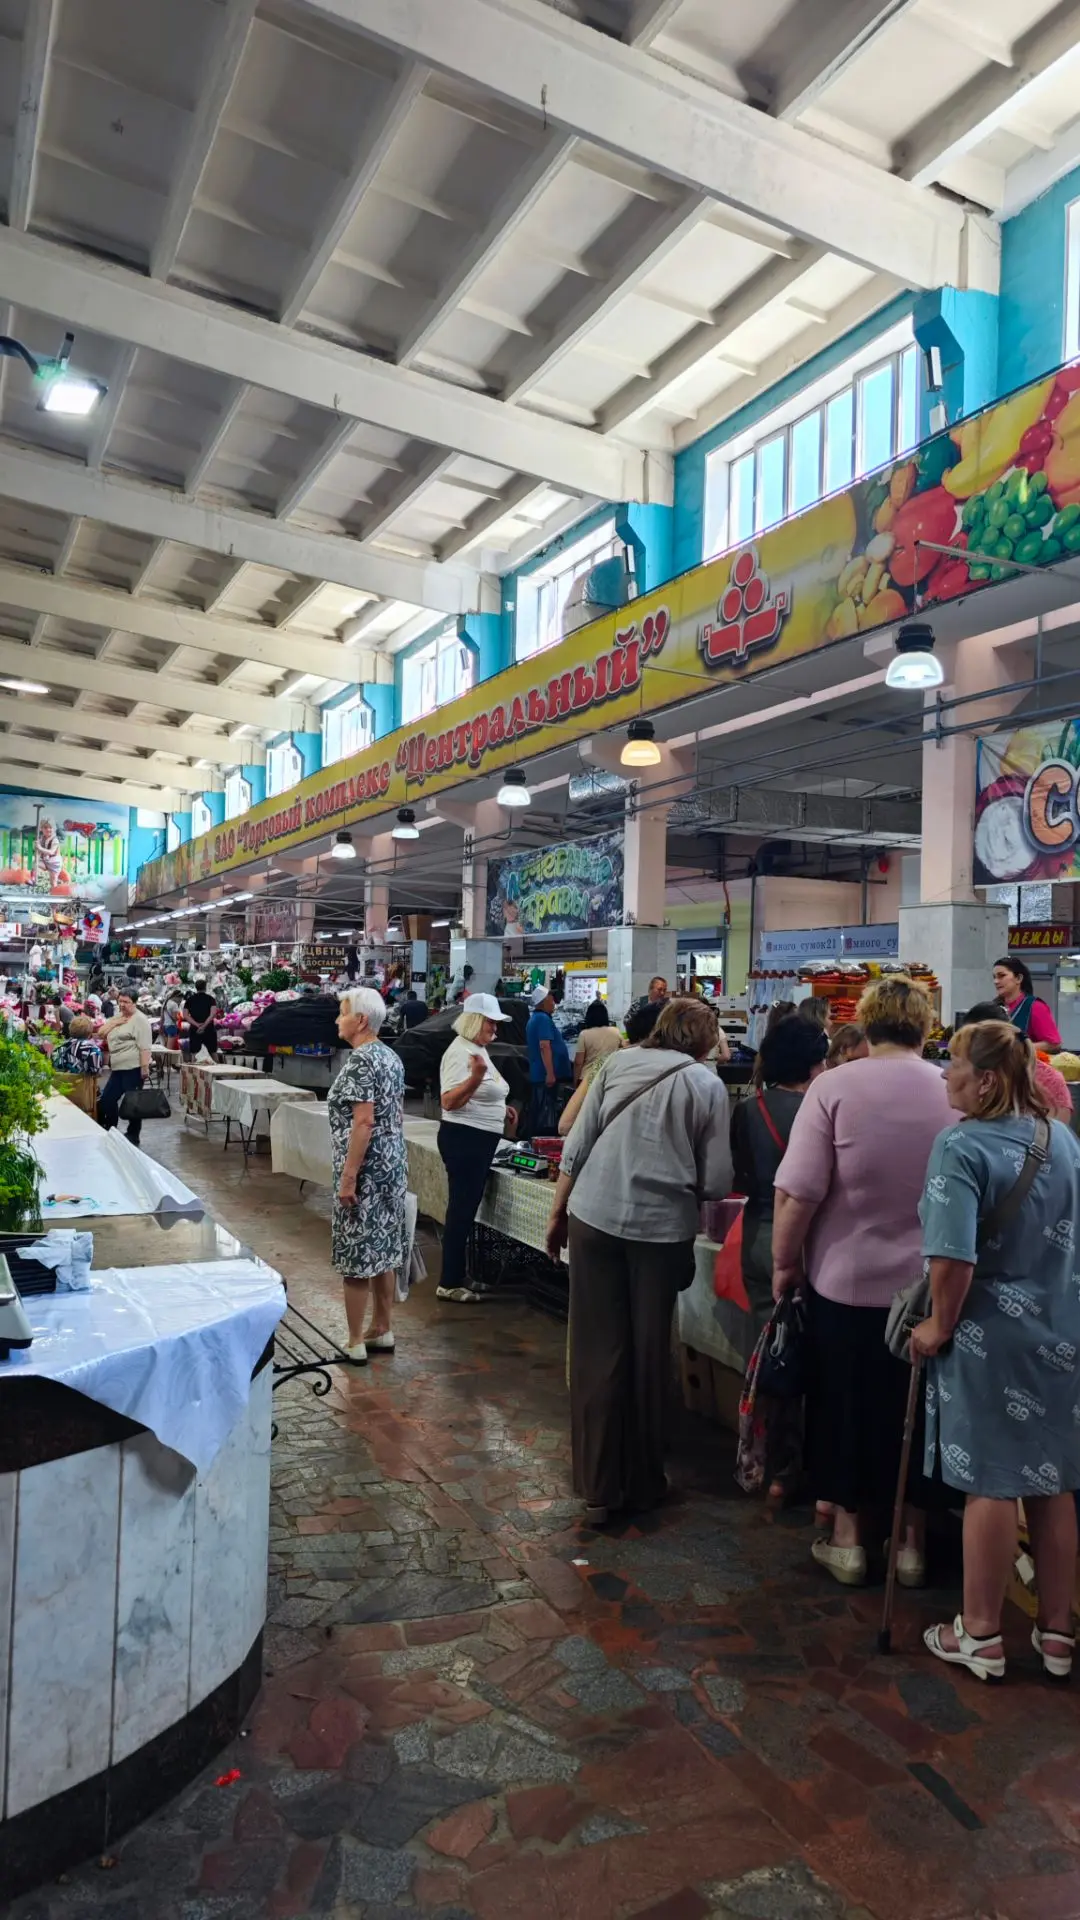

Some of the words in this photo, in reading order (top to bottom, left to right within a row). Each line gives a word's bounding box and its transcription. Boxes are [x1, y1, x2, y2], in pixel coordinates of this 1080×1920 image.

[215, 829, 235, 863] ЗАО
[306, 761, 390, 825] комплекс
[306, 946, 345, 957] ЦВЕТЫ
